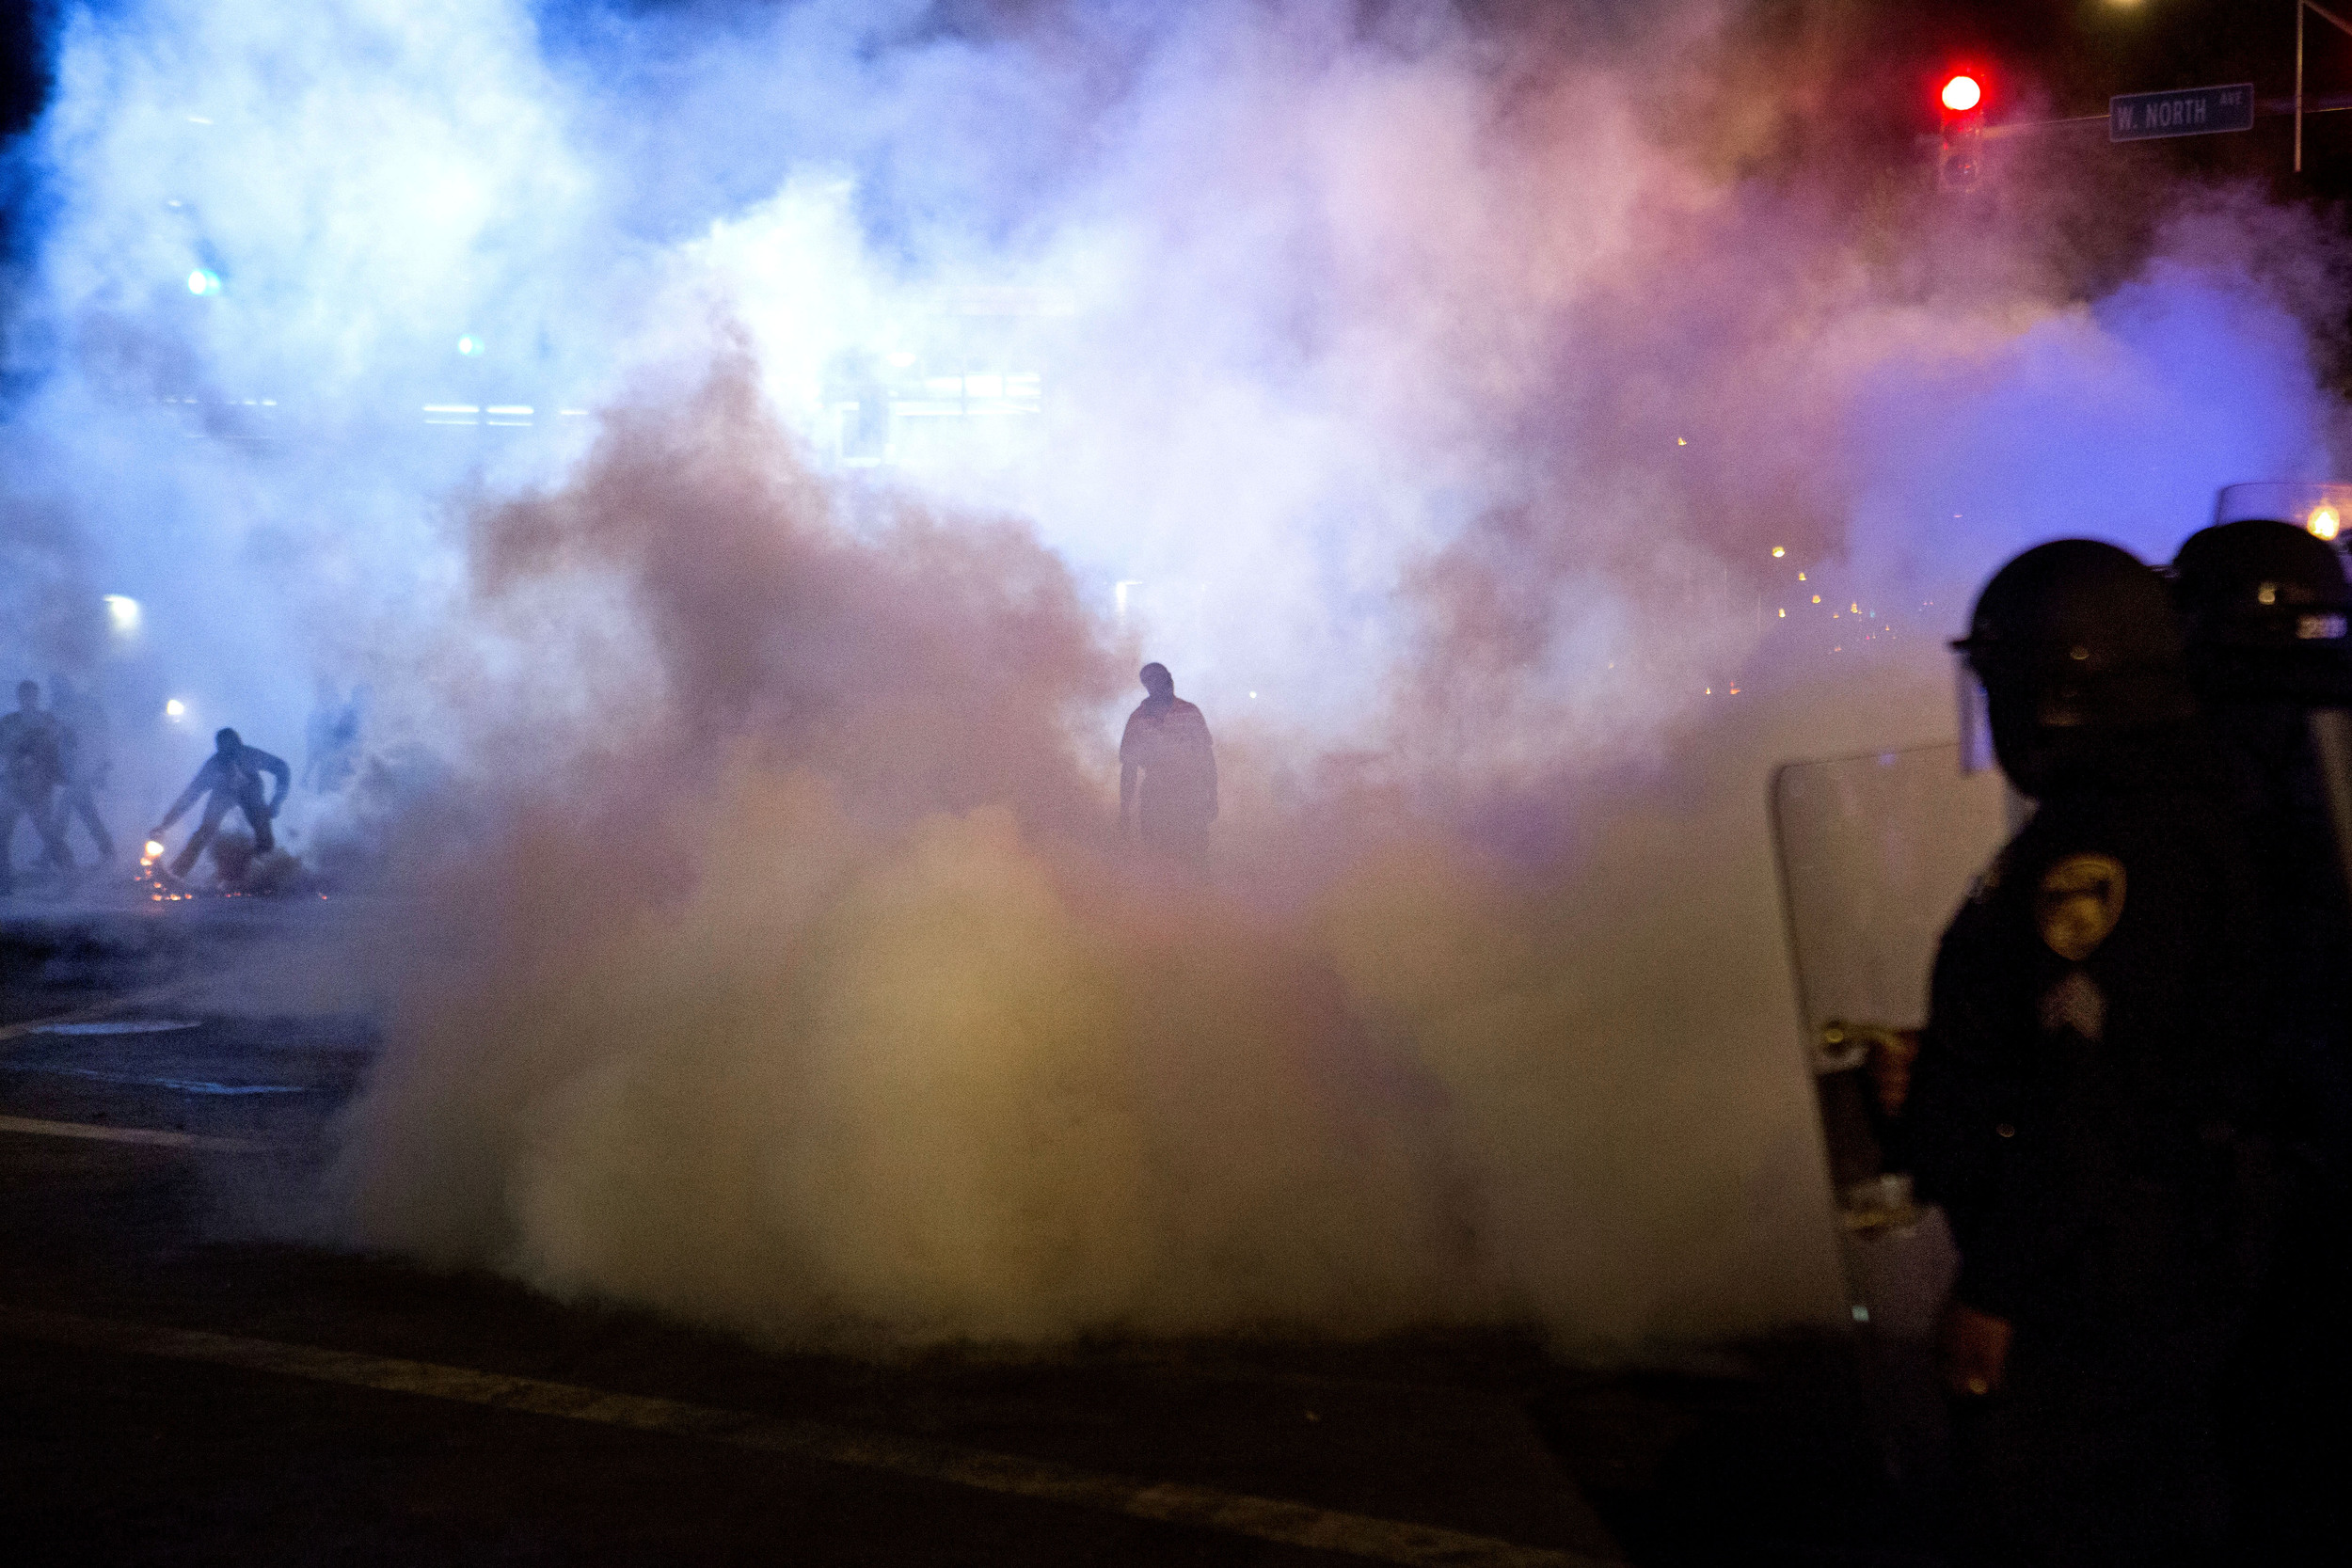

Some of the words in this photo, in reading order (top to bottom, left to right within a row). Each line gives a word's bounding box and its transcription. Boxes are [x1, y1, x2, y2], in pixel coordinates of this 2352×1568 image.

[2117, 105, 2138, 130] W.
[2146, 98, 2206, 129] NORTH
[2219, 91, 2243, 105] AVE
